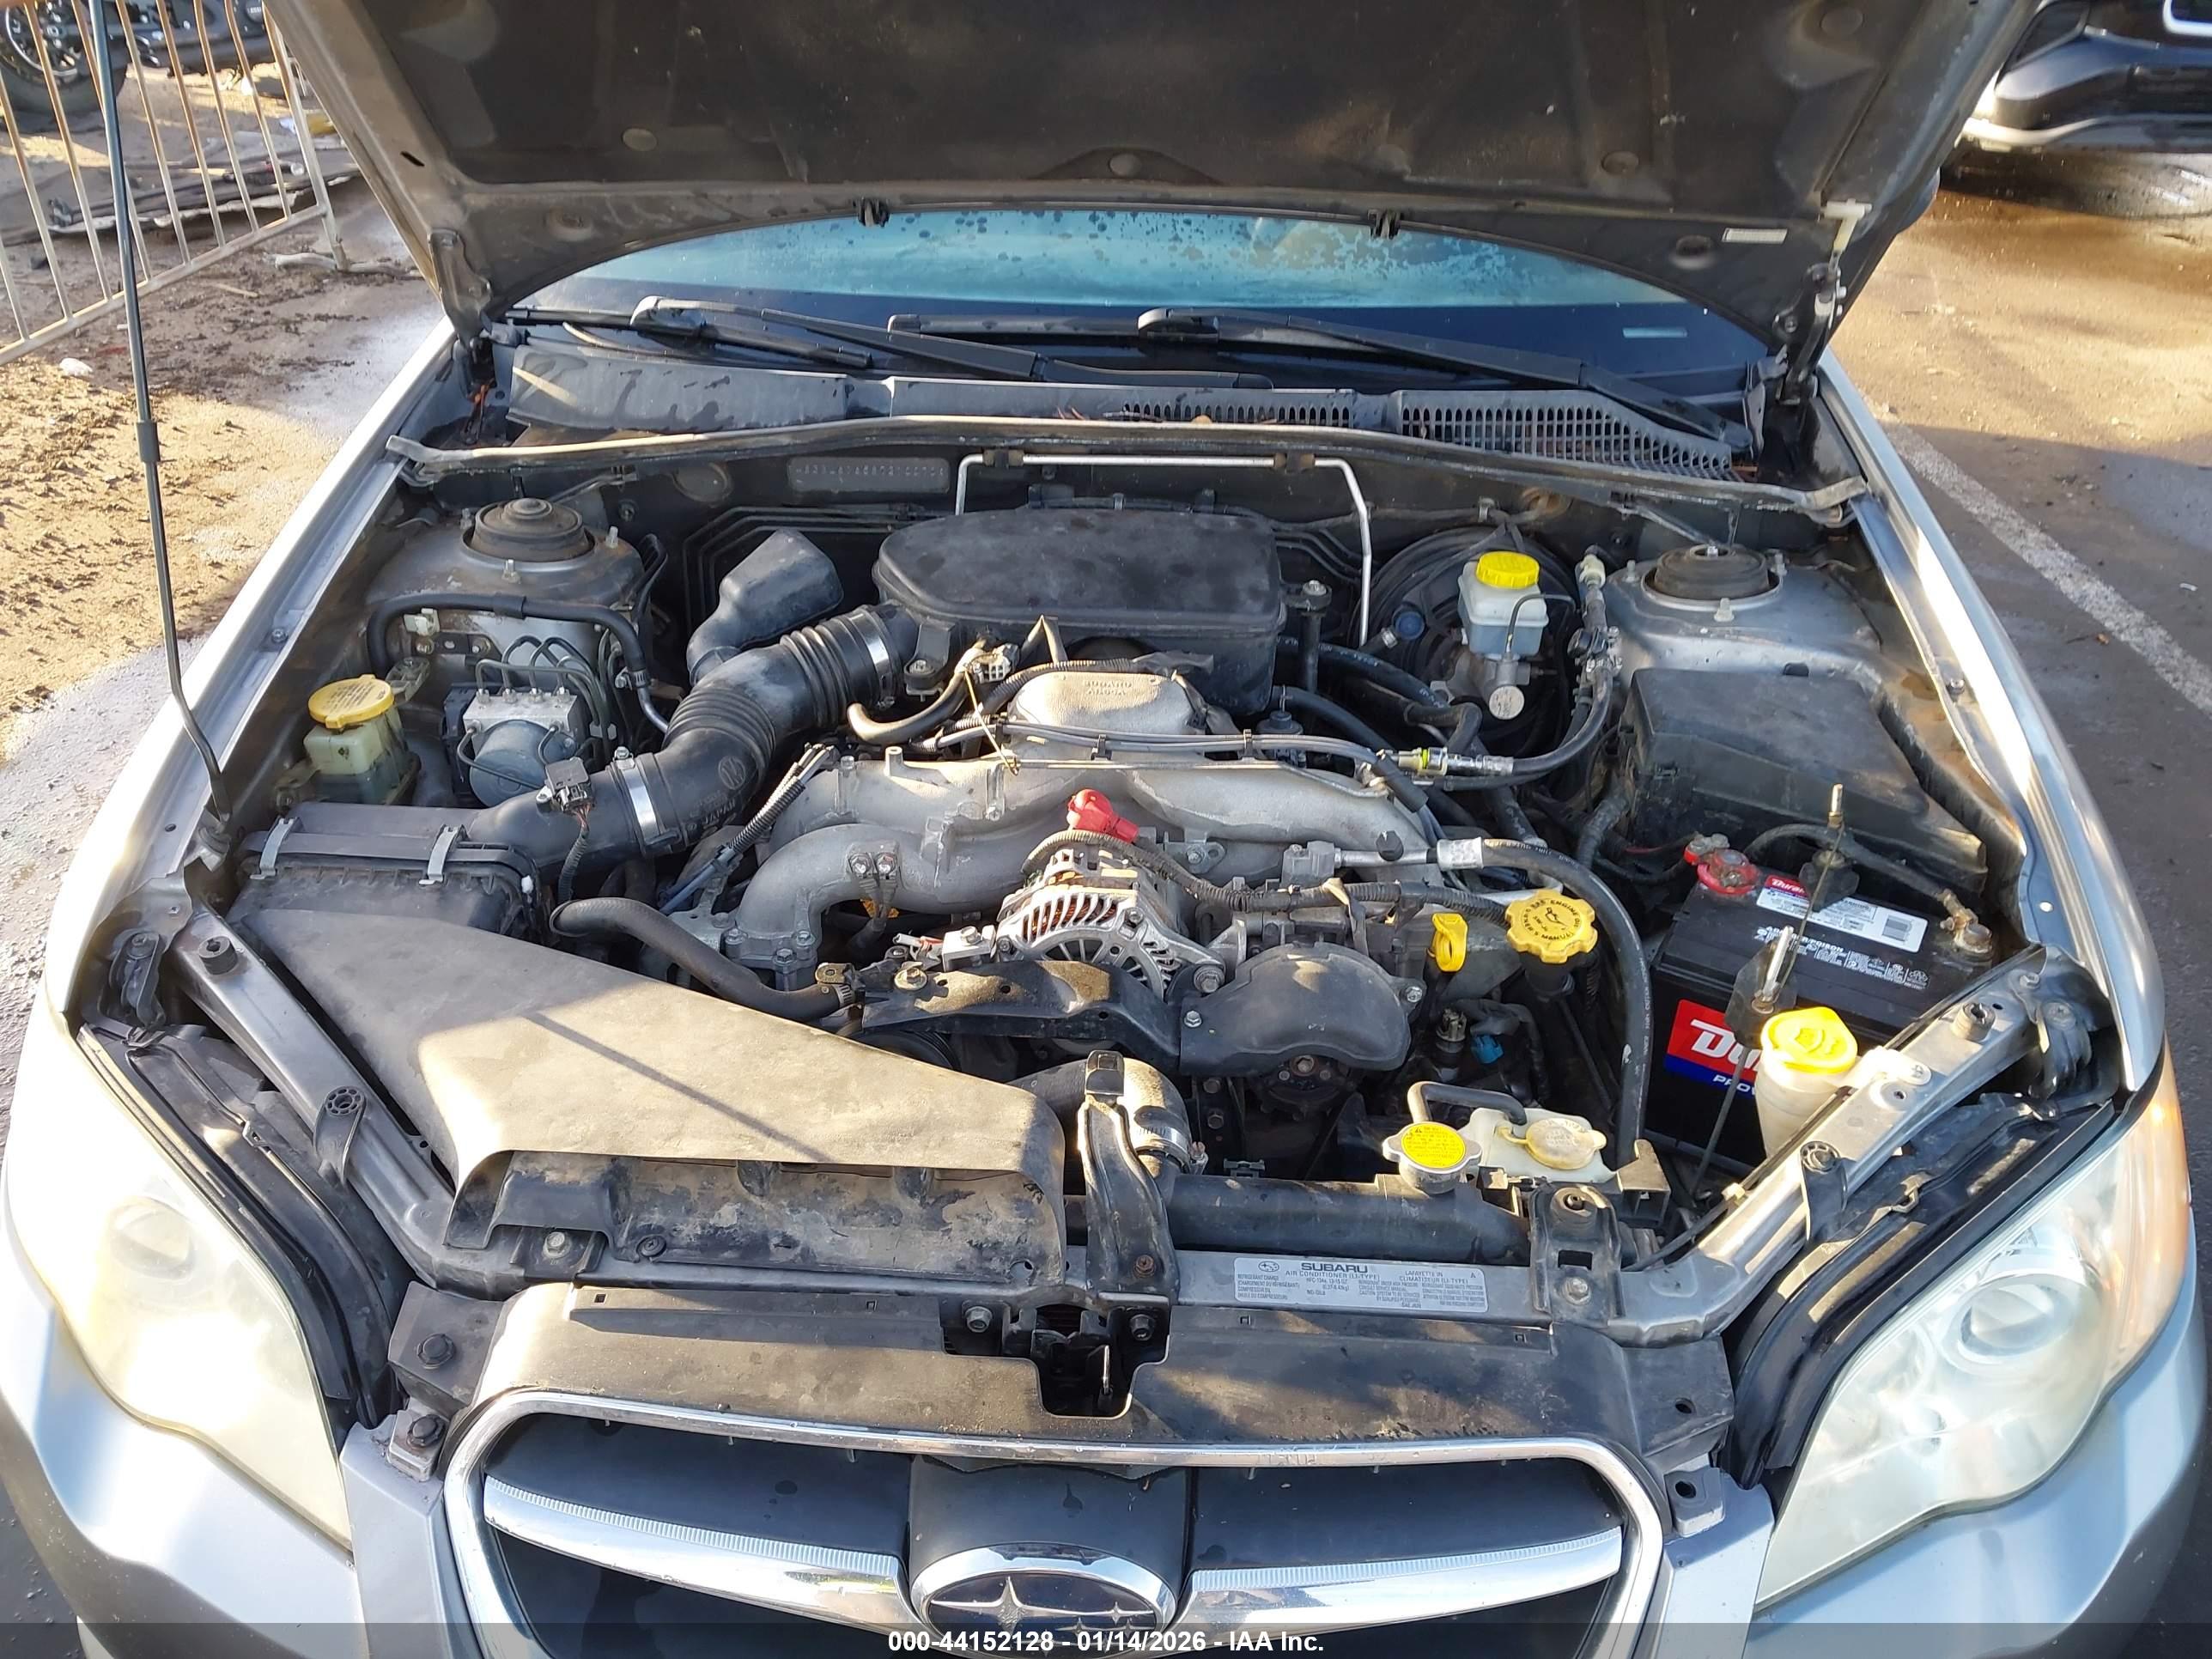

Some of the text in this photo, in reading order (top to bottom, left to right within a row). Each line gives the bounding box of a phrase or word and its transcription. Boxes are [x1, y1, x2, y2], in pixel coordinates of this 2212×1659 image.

[1550, 899, 1578, 916] ENGINE
[1301, 1262, 1368, 1273] SUBARU
[1299, 1271, 1347, 1279] CONDITIONER
